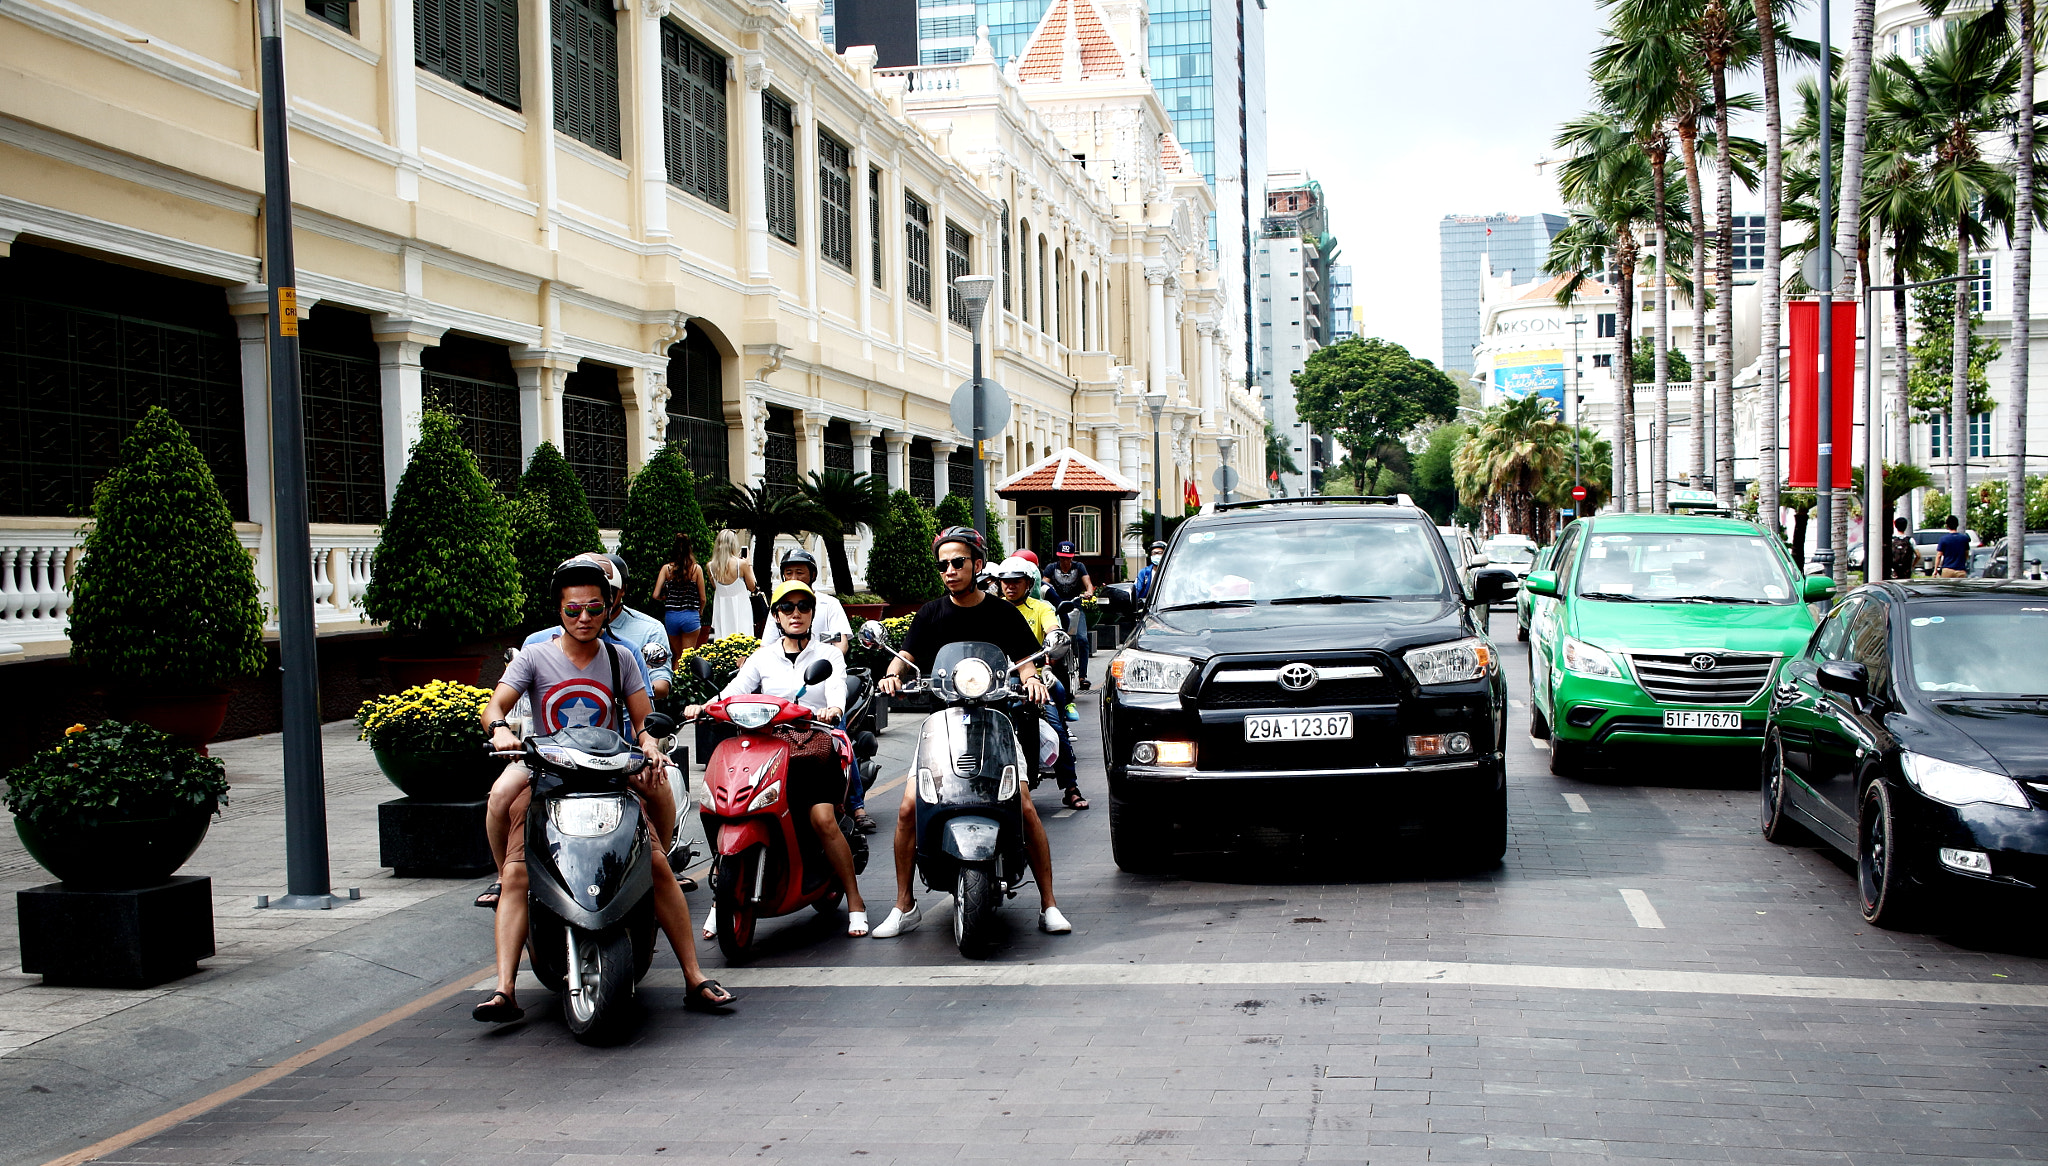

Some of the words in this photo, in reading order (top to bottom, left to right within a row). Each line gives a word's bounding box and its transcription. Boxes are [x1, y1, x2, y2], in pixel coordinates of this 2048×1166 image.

[1675, 491, 1713, 501] TAXI
[1249, 716, 1349, 739] 29A-123.67
[1666, 712, 1739, 728] 51F-176.70
